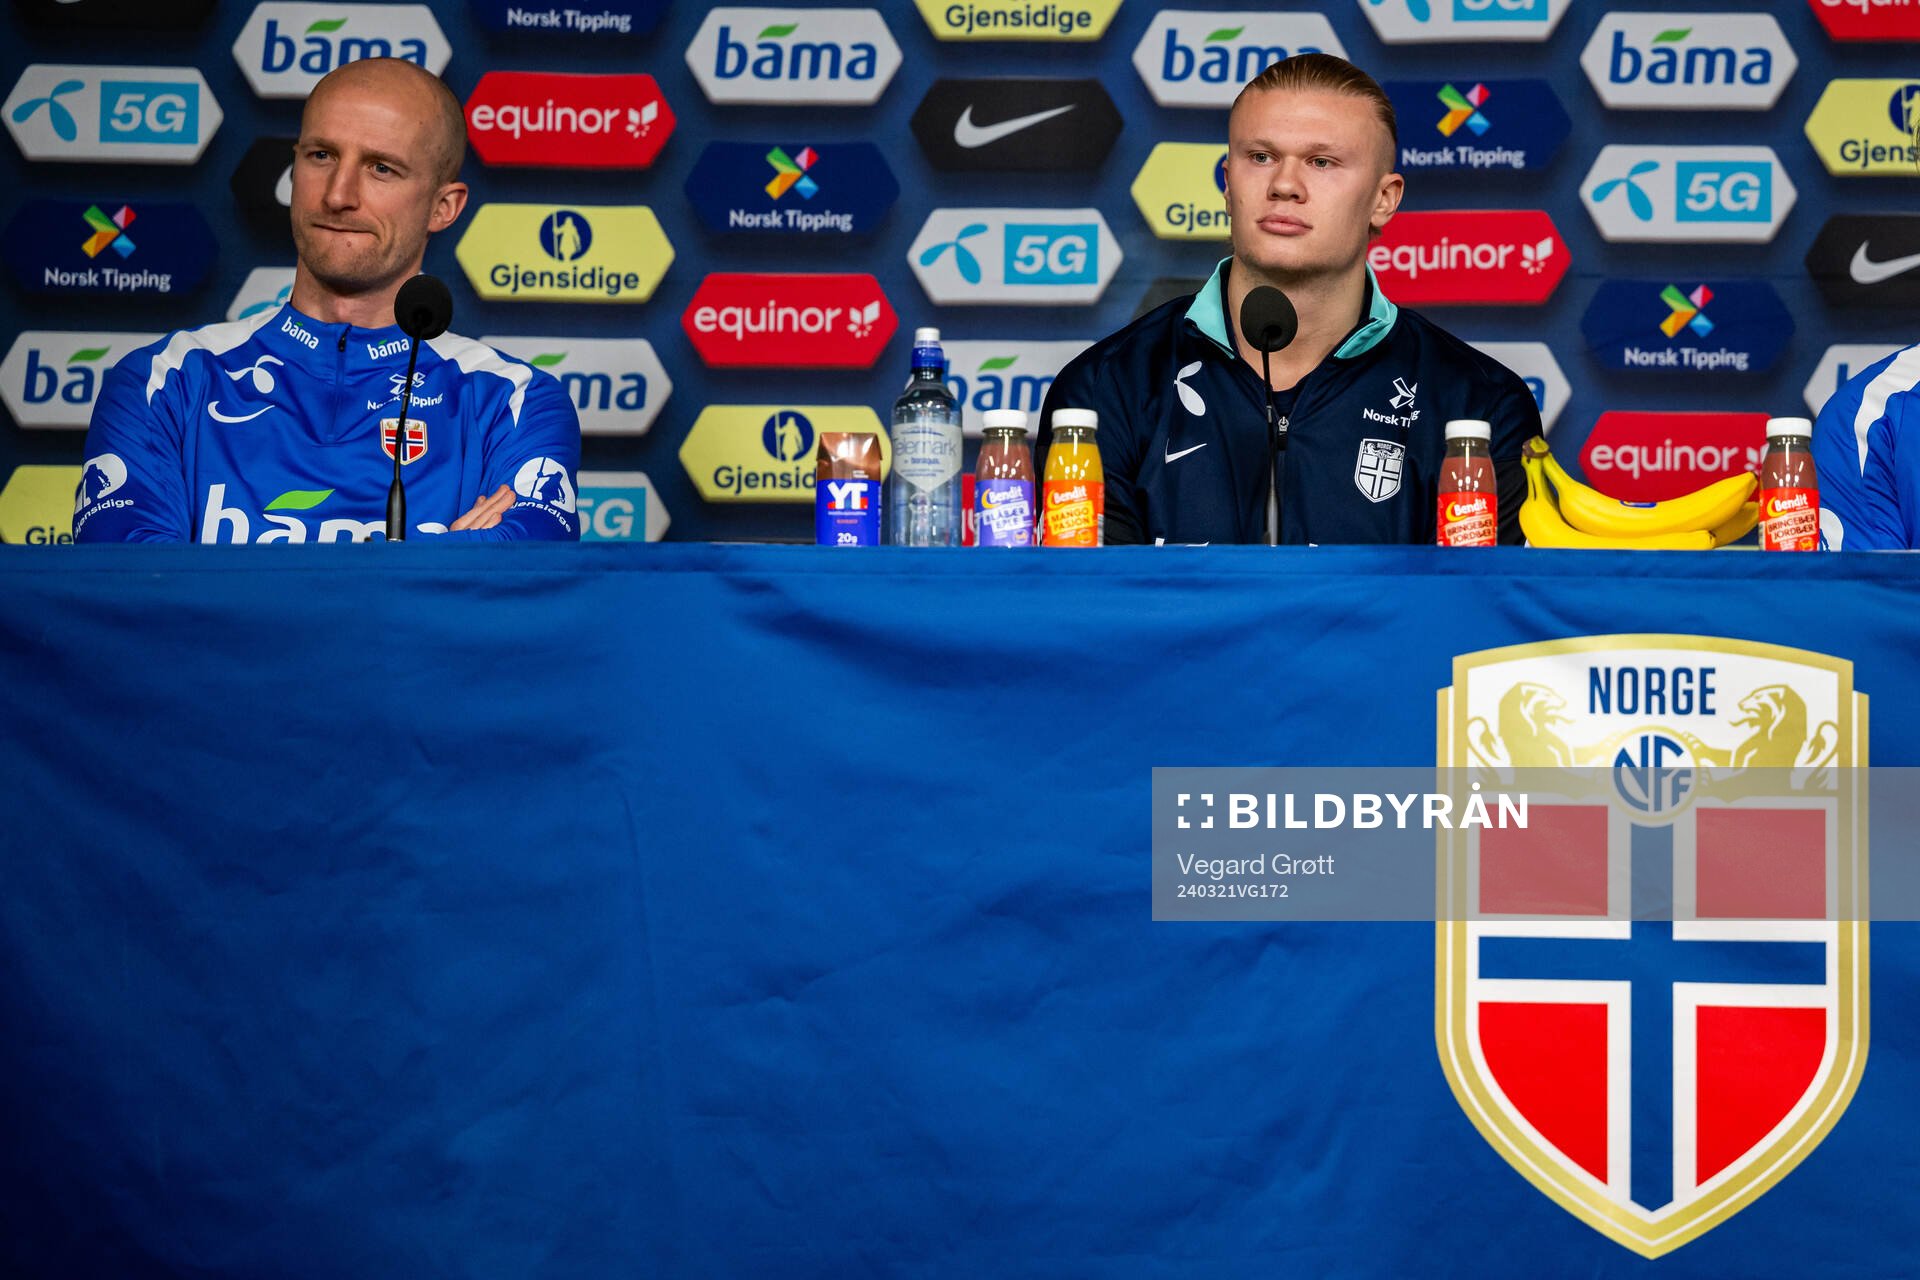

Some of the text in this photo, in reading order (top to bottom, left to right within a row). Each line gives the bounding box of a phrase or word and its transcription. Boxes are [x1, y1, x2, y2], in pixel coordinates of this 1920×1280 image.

[507, 8, 632, 33] Norsk Tipping
[945, 5, 1092, 34] Gjensidige
[714, 26, 877, 80] bama
[1162, 28, 1323, 82] bam
[1608, 31, 1773, 84] bama
[110, 93, 188, 133] 5G
[471, 100, 620, 139] equinor
[1401, 147, 1525, 170] Norsk Tipping
[1840, 139, 1917, 169] Gjens
[1686, 172, 1761, 212] 5G
[729, 210, 853, 232] Norsk Tipping
[1013, 235, 1088, 275] 5G
[1367, 237, 1515, 279] equinor
[44, 267, 171, 291] Norsk Tipping
[490, 264, 639, 295] Gjensidige
[281, 316, 319, 350] bama
[694, 300, 842, 340] equinor
[366, 338, 410, 361] bama
[1624, 347, 1749, 371] Norsk Tipping
[1362, 407, 1399, 426] Norsk
[1589, 438, 1739, 479] equinor
[713, 465, 817, 495] Gjensid
[989, 486, 1023, 504] Bendit
[1053, 486, 1088, 505] Bendit
[1453, 498, 1488, 516] Bendit
[1774, 493, 1808, 511] Bendit
[512, 501, 571, 532] jensidige
[1589, 667, 1717, 716] NORGE
